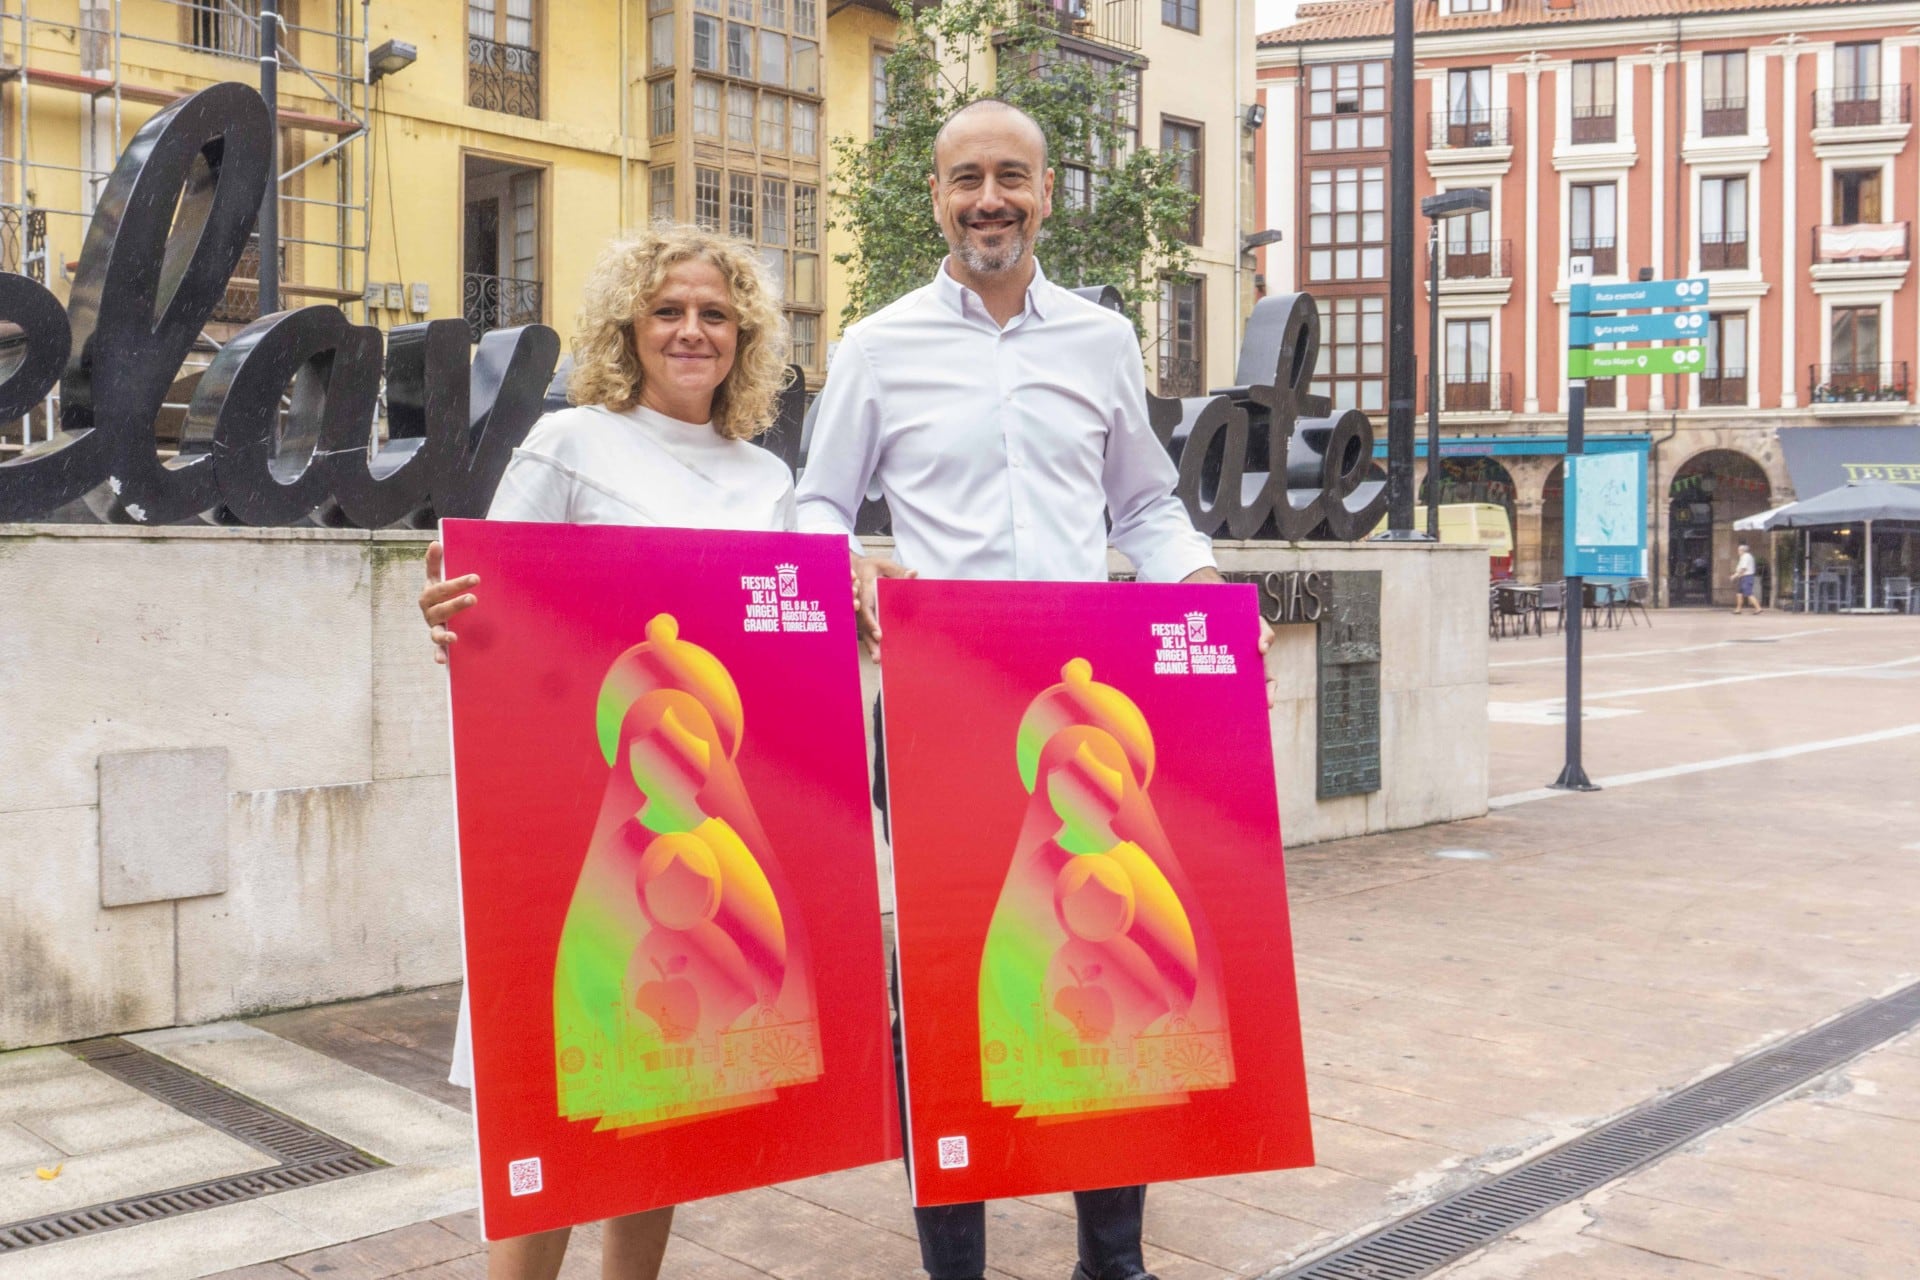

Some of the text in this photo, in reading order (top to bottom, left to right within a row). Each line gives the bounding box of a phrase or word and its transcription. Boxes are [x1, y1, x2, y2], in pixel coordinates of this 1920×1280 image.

[1596, 290, 1646, 302] Ruta esencial
[1593, 357, 1635, 367] Plaza Mayor
[741, 576, 776, 590] FIESTAS
[752, 591, 777, 604] DE LA
[746, 604, 778, 618] VIRGEN
[781, 601, 793, 610] DEL
[801, 601, 809, 610] AL
[810, 600, 819, 610] 17
[782, 611, 826, 621] AGOSTO 2025
[744, 619, 779, 632] GRANDE
[782, 622, 828, 632] TORRELAVEGA
[1151, 624, 1186, 636] FIESTAS
[1162, 637, 1187, 649] DE LA
[1156, 649, 1188, 661] VIRGEN
[1190, 645, 1202, 654] DEL
[1209, 645, 1217, 654] AL
[1219, 645, 1228, 654] 17
[1191, 655, 1235, 664] AGOSTO 2025
[1154, 662, 1189, 675] GRANDE
[1191, 665, 1237, 674] TORRELAVEGA
